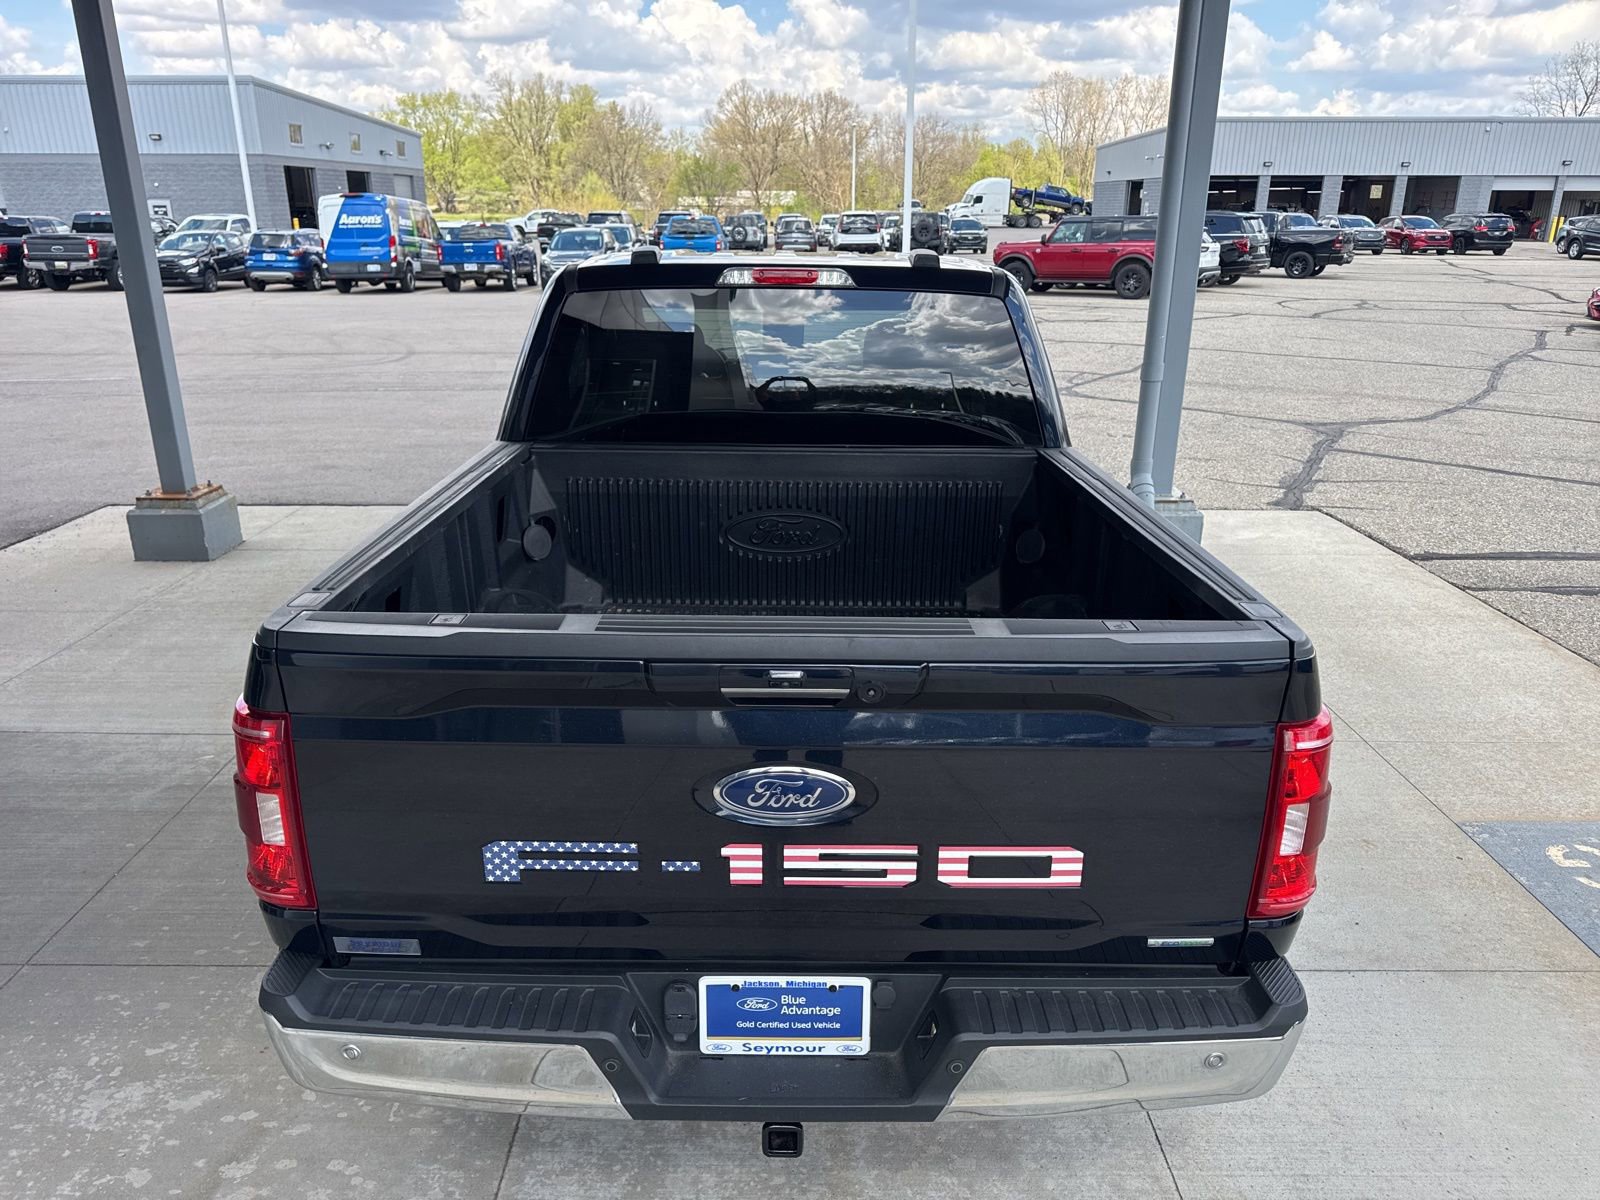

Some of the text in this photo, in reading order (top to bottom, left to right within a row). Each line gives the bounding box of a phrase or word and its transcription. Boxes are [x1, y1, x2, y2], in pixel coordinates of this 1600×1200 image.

[339, 213, 383, 225] Aaron's
[746, 778, 820, 809] Ford
[482, 840, 1084, 888] F-150
[741, 980, 828, 988] Jackson, Michigan
[743, 999, 770, 1010] Ford
[780, 994, 806, 1005] Blue
[780, 1005, 841, 1017] Advantage
[736, 1020, 841, 1029] Gold Certified Used Vehicle
[742, 1042, 826, 1055] Seymour
